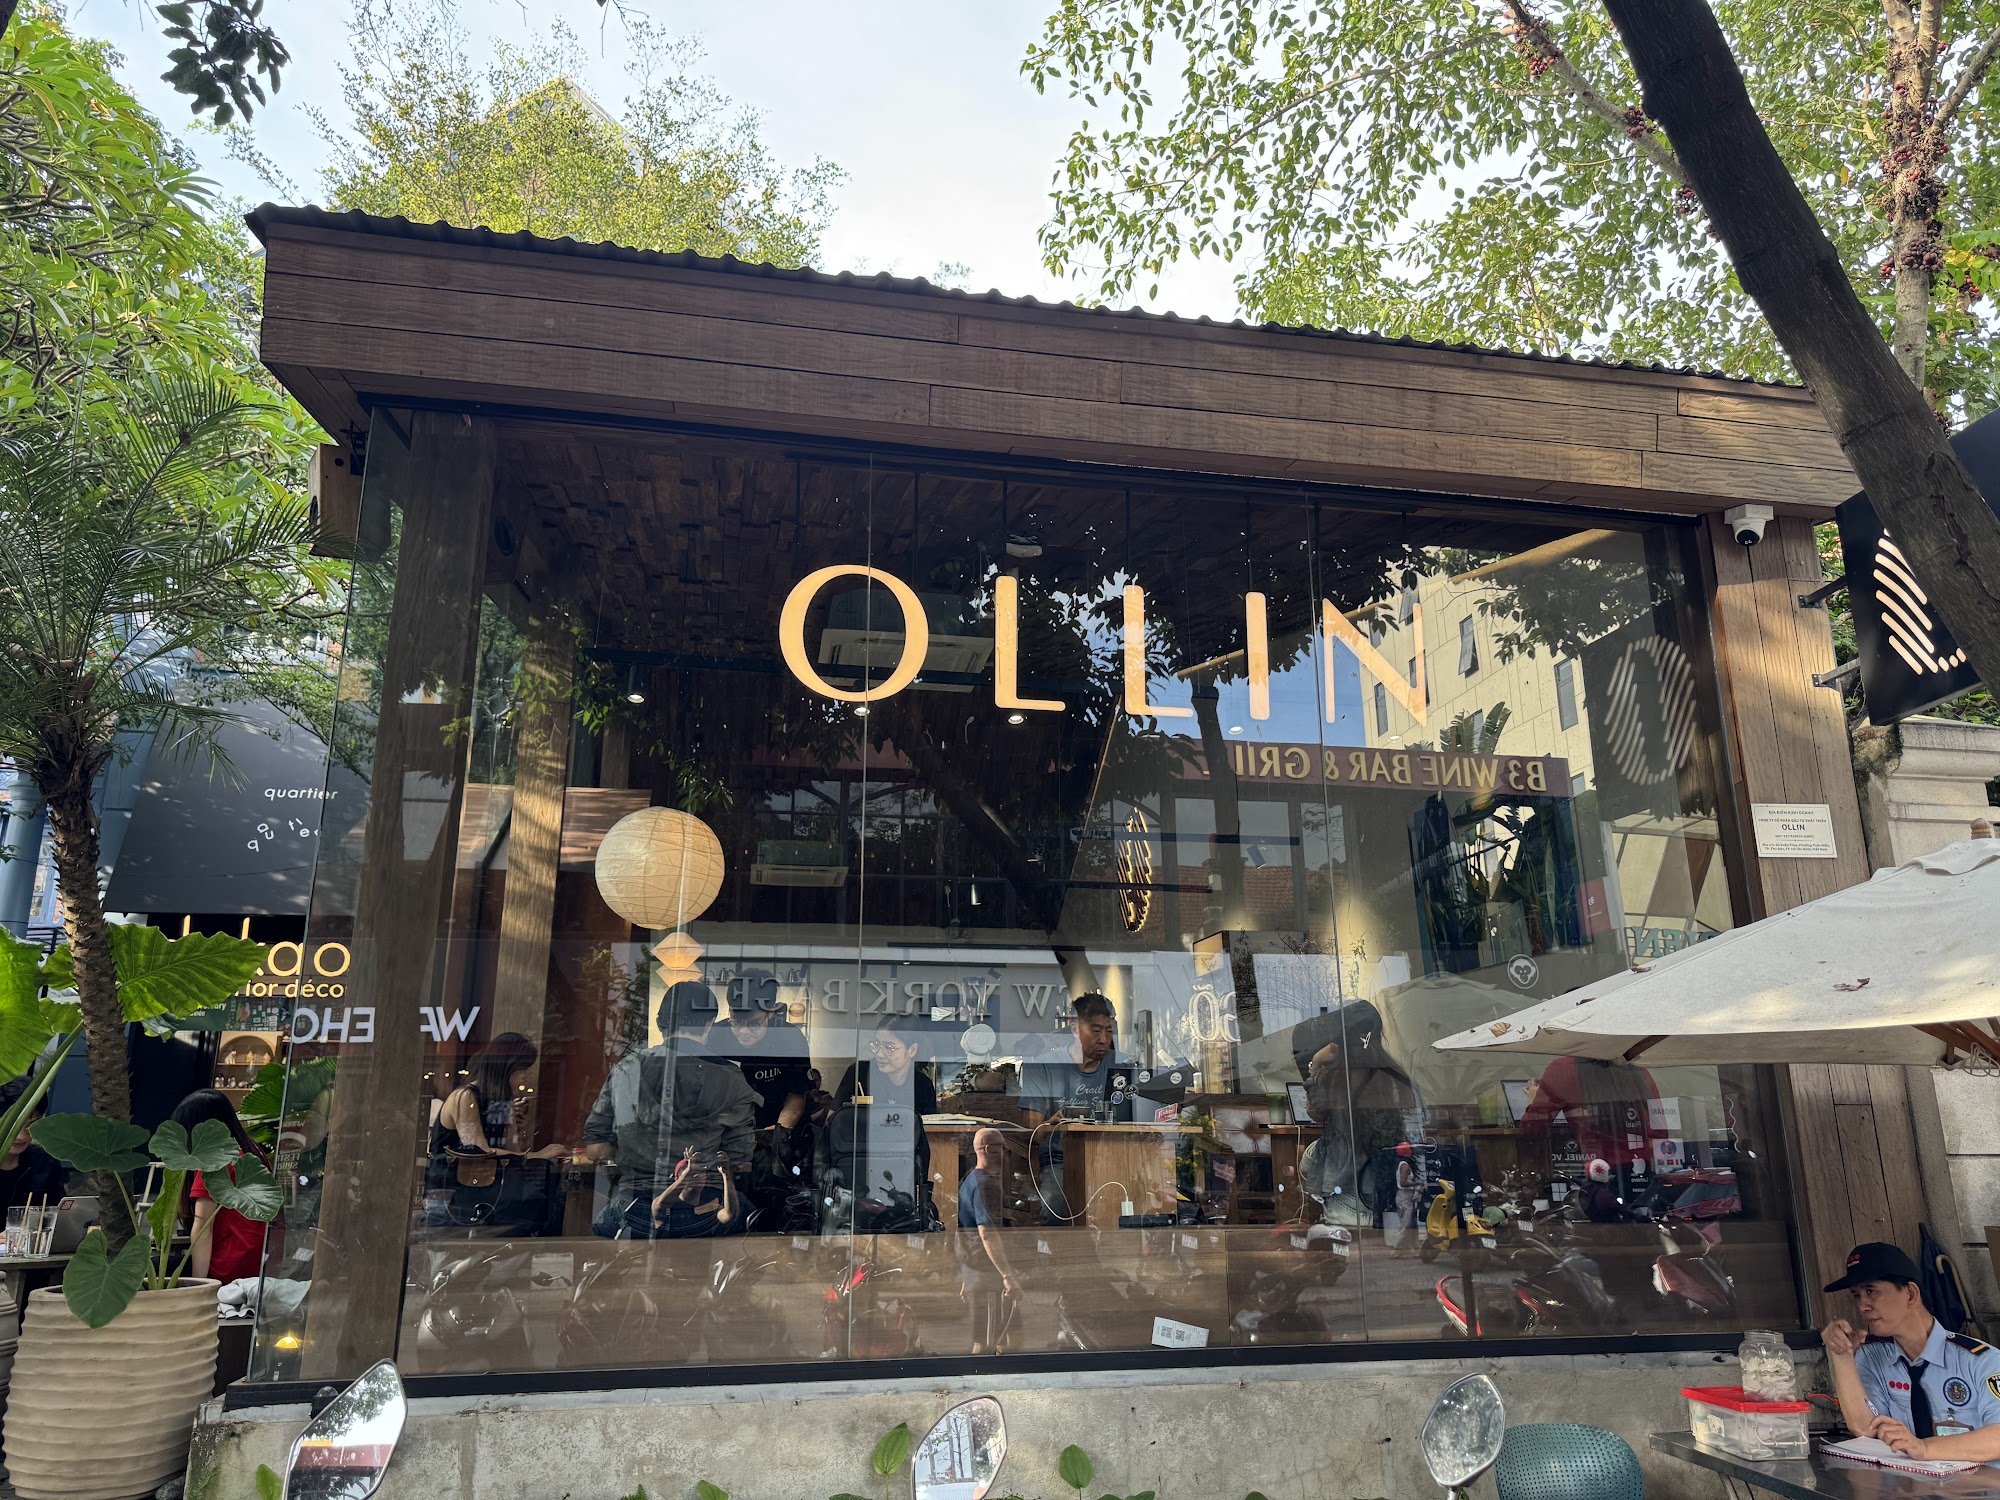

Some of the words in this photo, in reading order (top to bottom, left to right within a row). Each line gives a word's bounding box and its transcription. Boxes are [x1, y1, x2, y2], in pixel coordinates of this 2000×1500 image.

[779, 564, 1428, 727] OLLIN
[264, 787, 338, 801] quartier
[1781, 823, 1805, 831] OLLIN
[284, 978, 345, 998] déco
[1075, 1083, 1104, 1096] Crail
